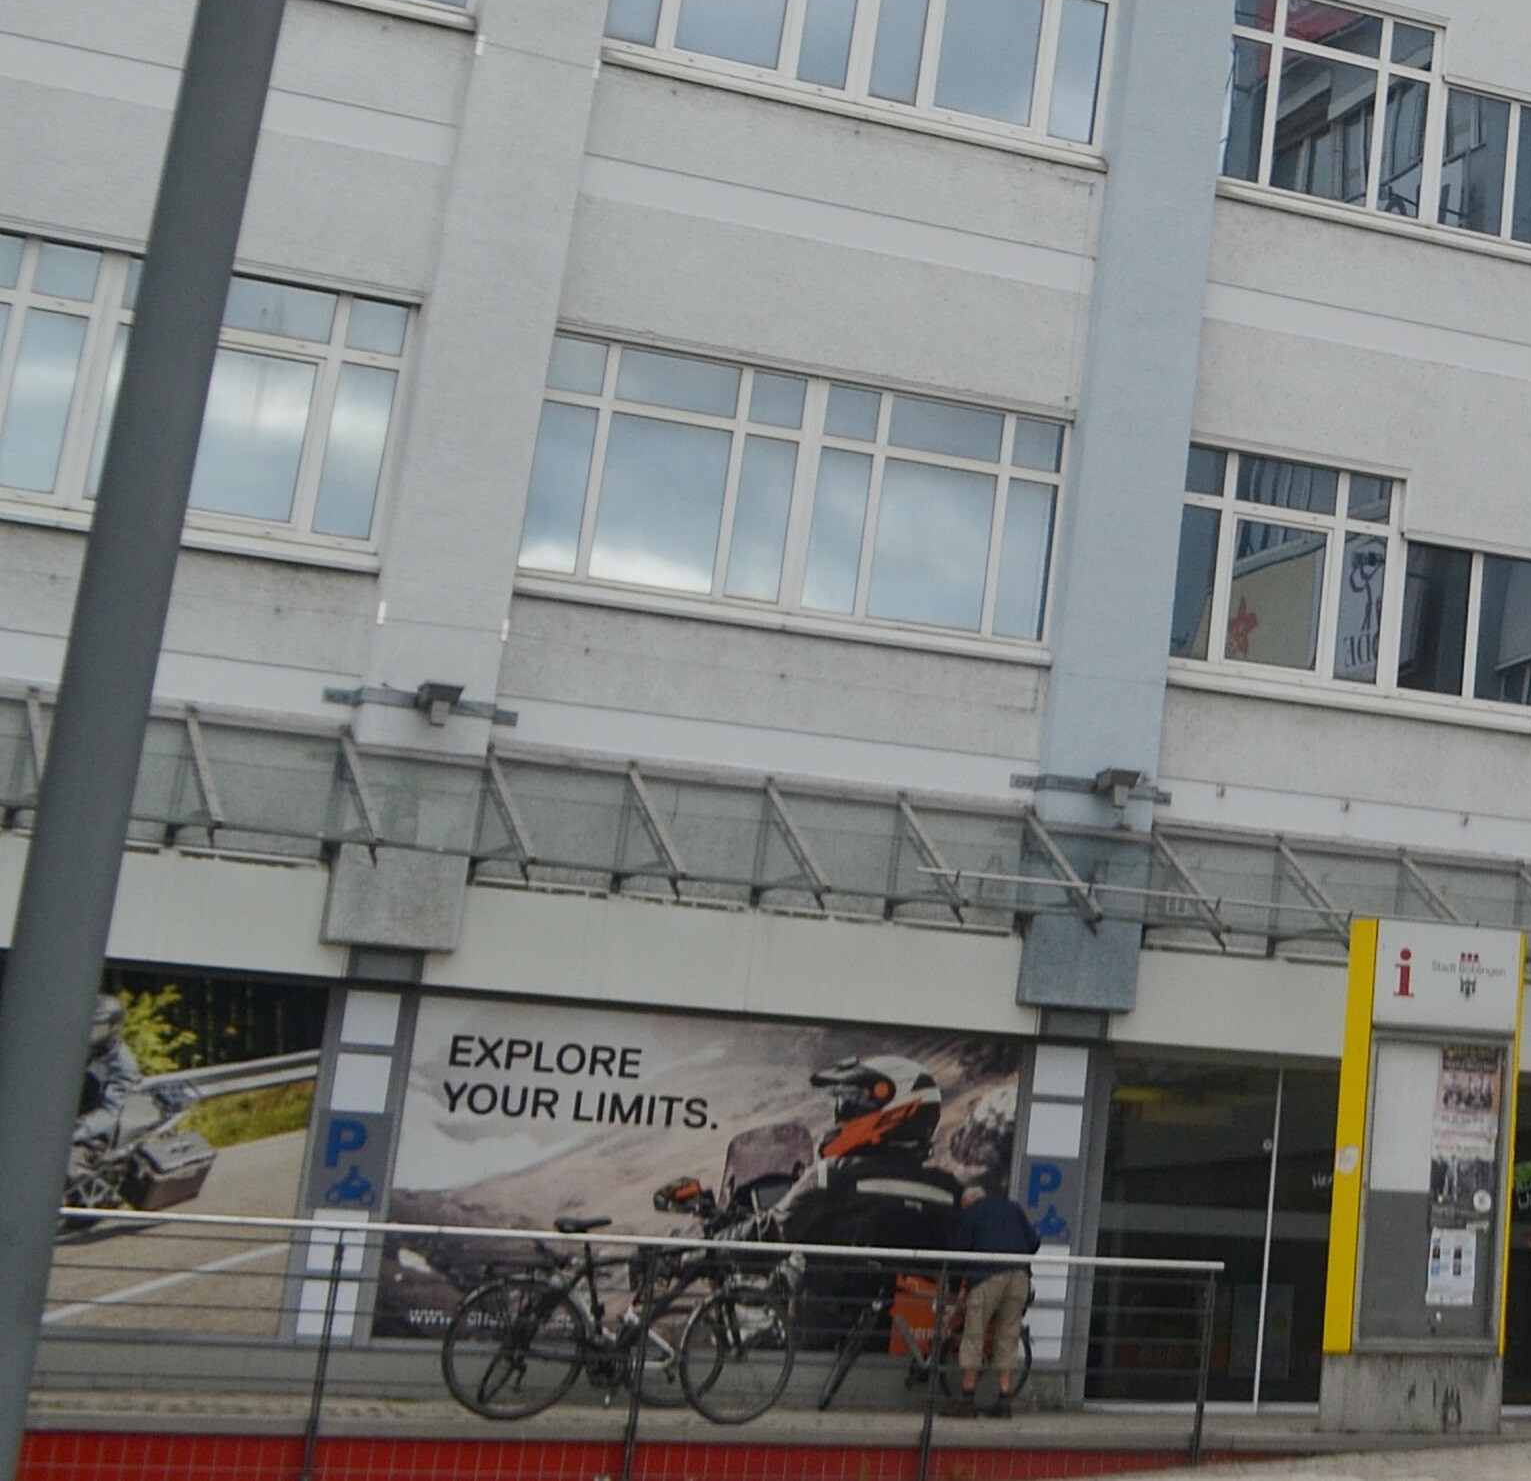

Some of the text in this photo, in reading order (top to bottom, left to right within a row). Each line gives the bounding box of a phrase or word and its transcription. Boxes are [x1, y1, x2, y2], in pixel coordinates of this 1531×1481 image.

[447, 1034, 642, 1079] EXPLORE
[443, 1081, 719, 1131] YOUR LIMITS.
[325, 1120, 367, 1168] P
[1028, 1163, 1062, 1206] P
